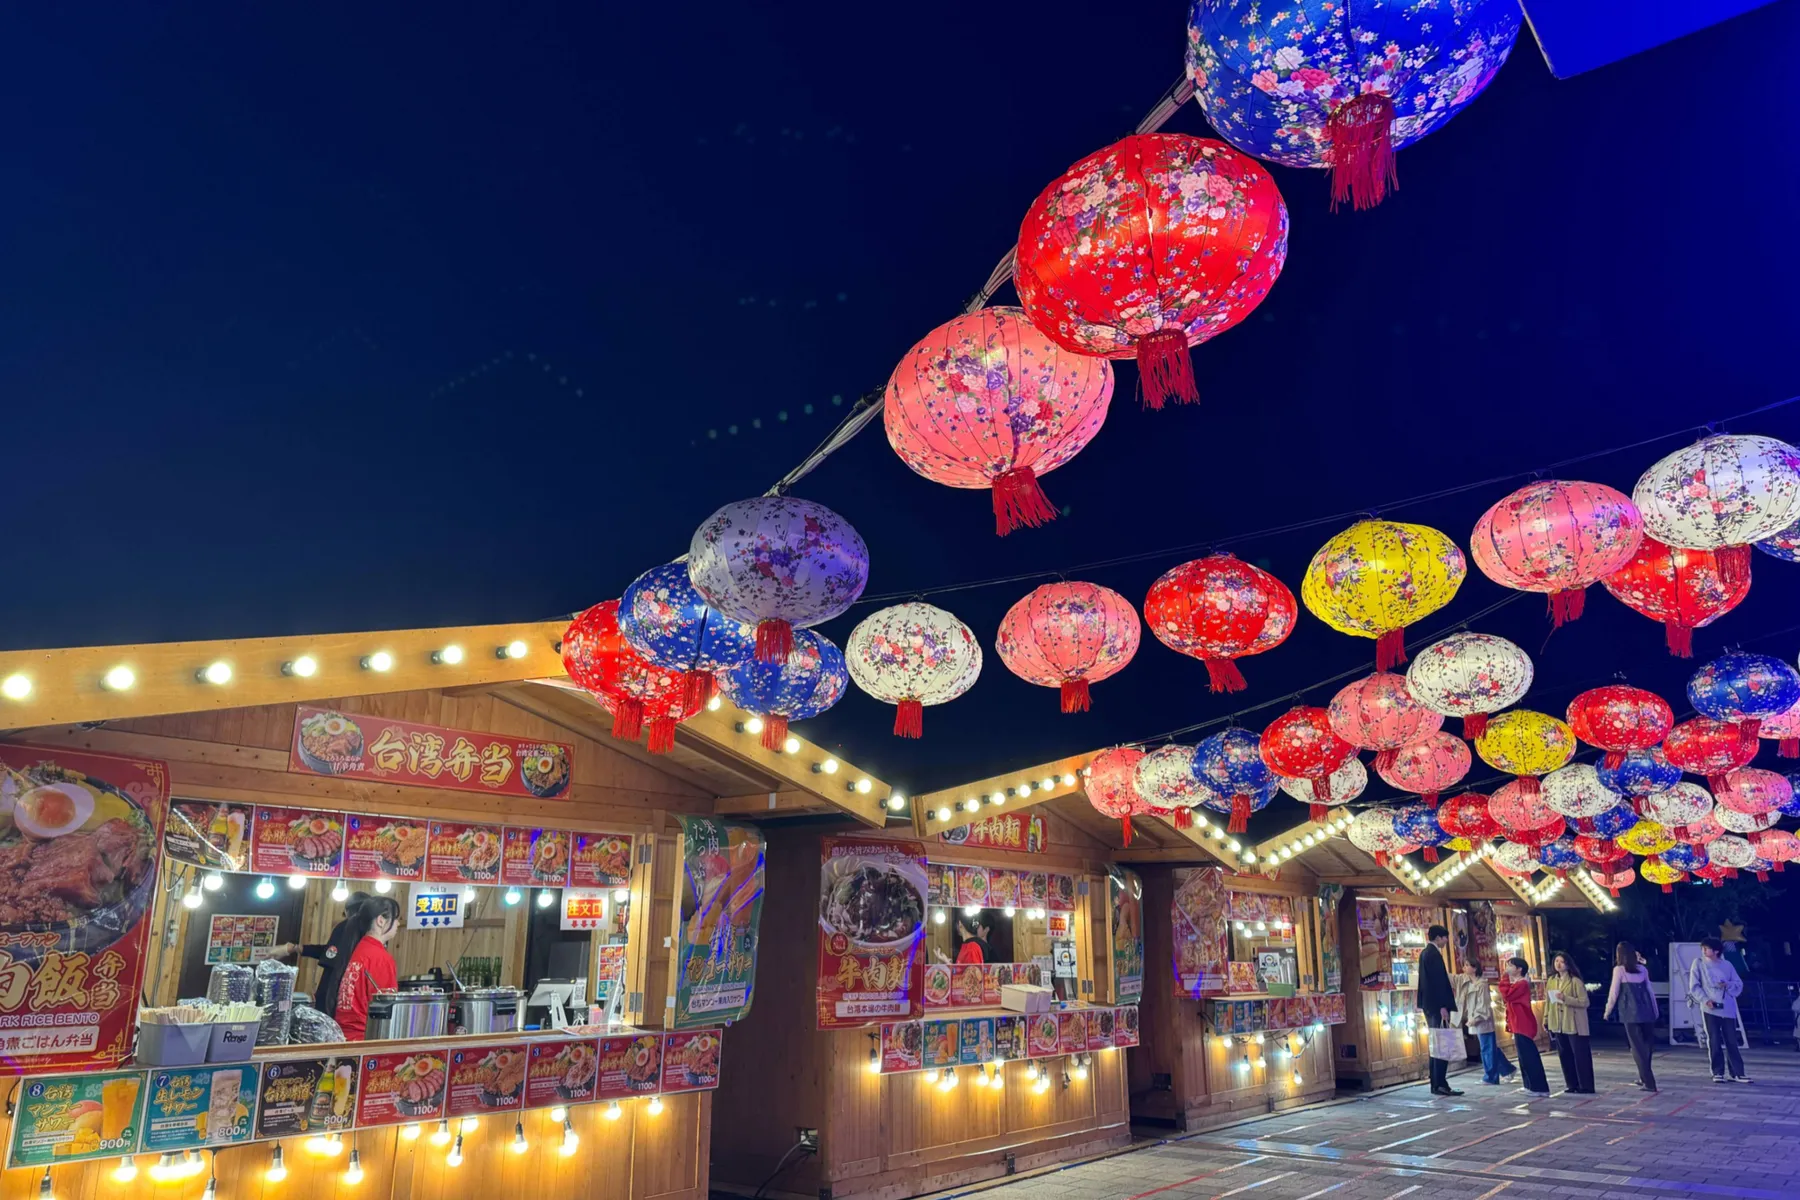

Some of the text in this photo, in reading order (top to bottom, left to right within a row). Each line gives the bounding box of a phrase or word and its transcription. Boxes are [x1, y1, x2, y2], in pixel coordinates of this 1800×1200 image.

[368, 729, 514, 785] 台湾弁当
[416, 897, 457, 913] 受取口
[567, 901, 602, 916] 注文口
[91, 951, 126, 1009] 弁当
[836, 955, 912, 991] 牛肉麺
[21, 1013, 55, 1026] RICE
[56, 1012, 99, 1025] BENTO
[270, 1067, 278, 1078] 6
[159, 1075, 167, 1086] 7
[32, 1084, 41, 1096] 8
[44, 1084, 74, 1100] 台湾
[154, 1087, 204, 1104] 生レモン
[28, 1101, 82, 1117] マンゴー
[161, 1102, 198, 1116] サワー
[34, 1118, 76, 1133] サワー
[218, 1125, 247, 1137] 800円
[100, 1138, 131, 1150] 900円
